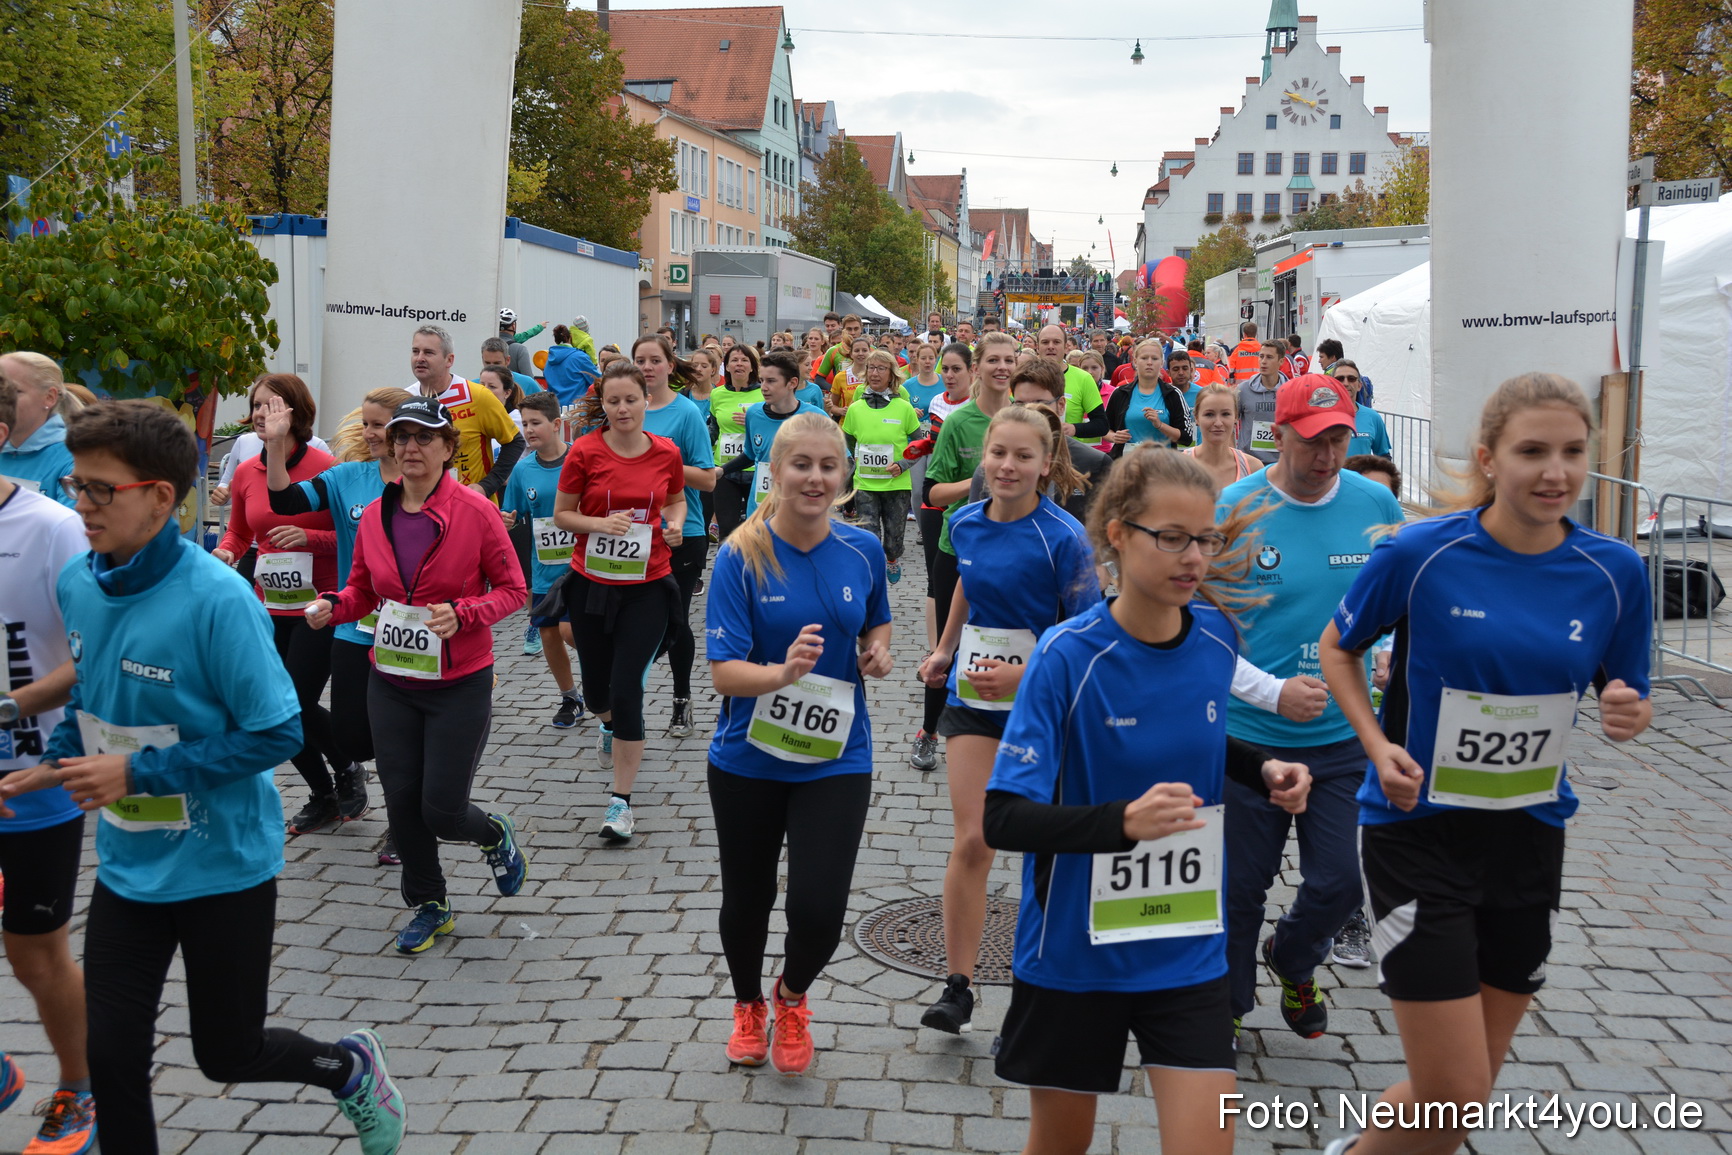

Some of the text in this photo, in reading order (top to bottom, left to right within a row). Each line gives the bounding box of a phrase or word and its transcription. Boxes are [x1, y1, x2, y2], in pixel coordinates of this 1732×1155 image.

[1658, 183, 1713, 201] Rainbügl
[672, 267, 686, 281] D
[325, 301, 467, 322] www.bmw-laufsport.de
[452, 408, 475, 421] ÖGL
[1257, 430, 1275, 441] 522
[863, 454, 888, 466] 5106
[595, 536, 641, 559] 5122
[608, 562, 622, 570] Tina
[261, 570, 302, 589] 5059
[1256, 573, 1282, 581] PARTL
[769, 595, 785, 603] JAKO
[842, 586, 853, 602] 8
[1462, 608, 1486, 618] JAKO
[382, 623, 429, 651] 5026
[1568, 619, 1583, 642] 2
[984, 636, 1009, 645] BOCK
[395, 653, 414, 665] Vroni
[121, 658, 174, 683] BOCK
[801, 681, 832, 693] BOCK
[769, 694, 840, 734] 5166
[1206, 700, 1217, 723] 6
[1494, 705, 1539, 718] BOCK
[1115, 717, 1137, 727] JAKO
[781, 733, 812, 750] Hanna
[1456, 728, 1552, 766] 5237
[1110, 847, 1202, 891] 5116
[1140, 903, 1171, 916] Jana
